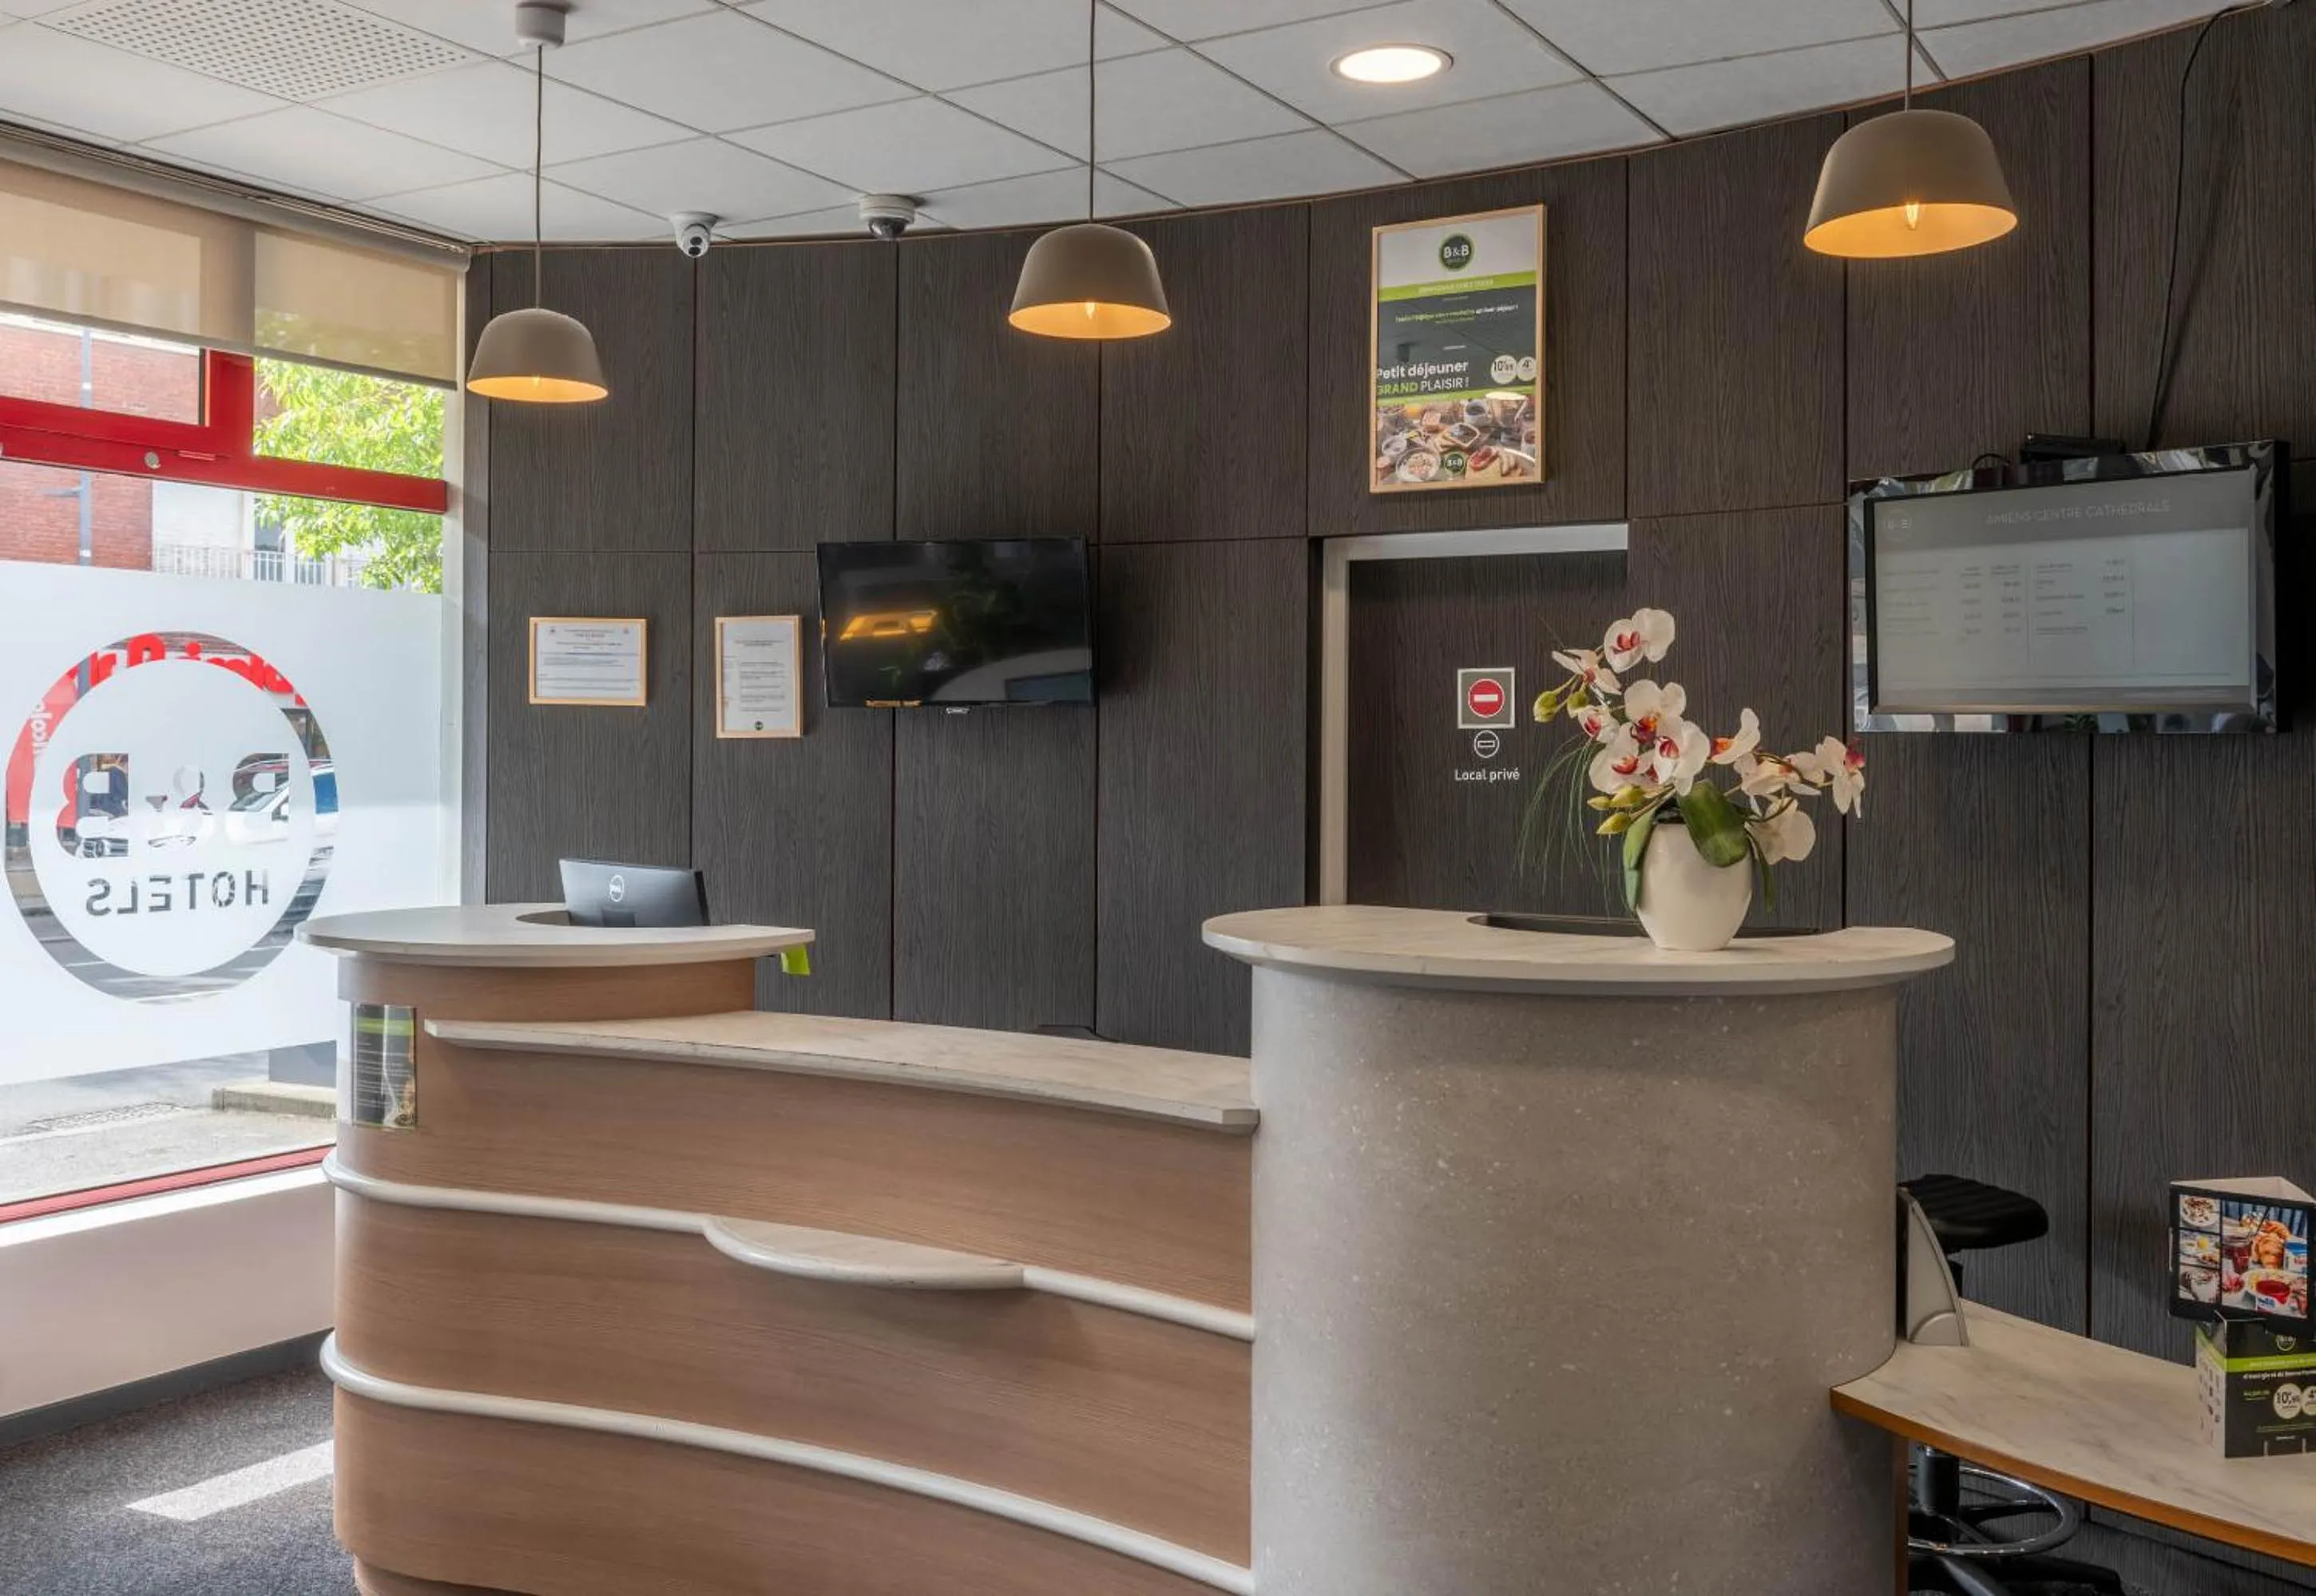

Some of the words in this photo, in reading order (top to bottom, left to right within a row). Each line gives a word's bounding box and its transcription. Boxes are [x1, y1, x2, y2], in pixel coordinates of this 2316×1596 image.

[1444, 244, 1469, 259] B&B
[1408, 361, 1469, 379] déjeuner
[1454, 769, 1486, 781] Local
[1489, 767, 1520, 782] privé
